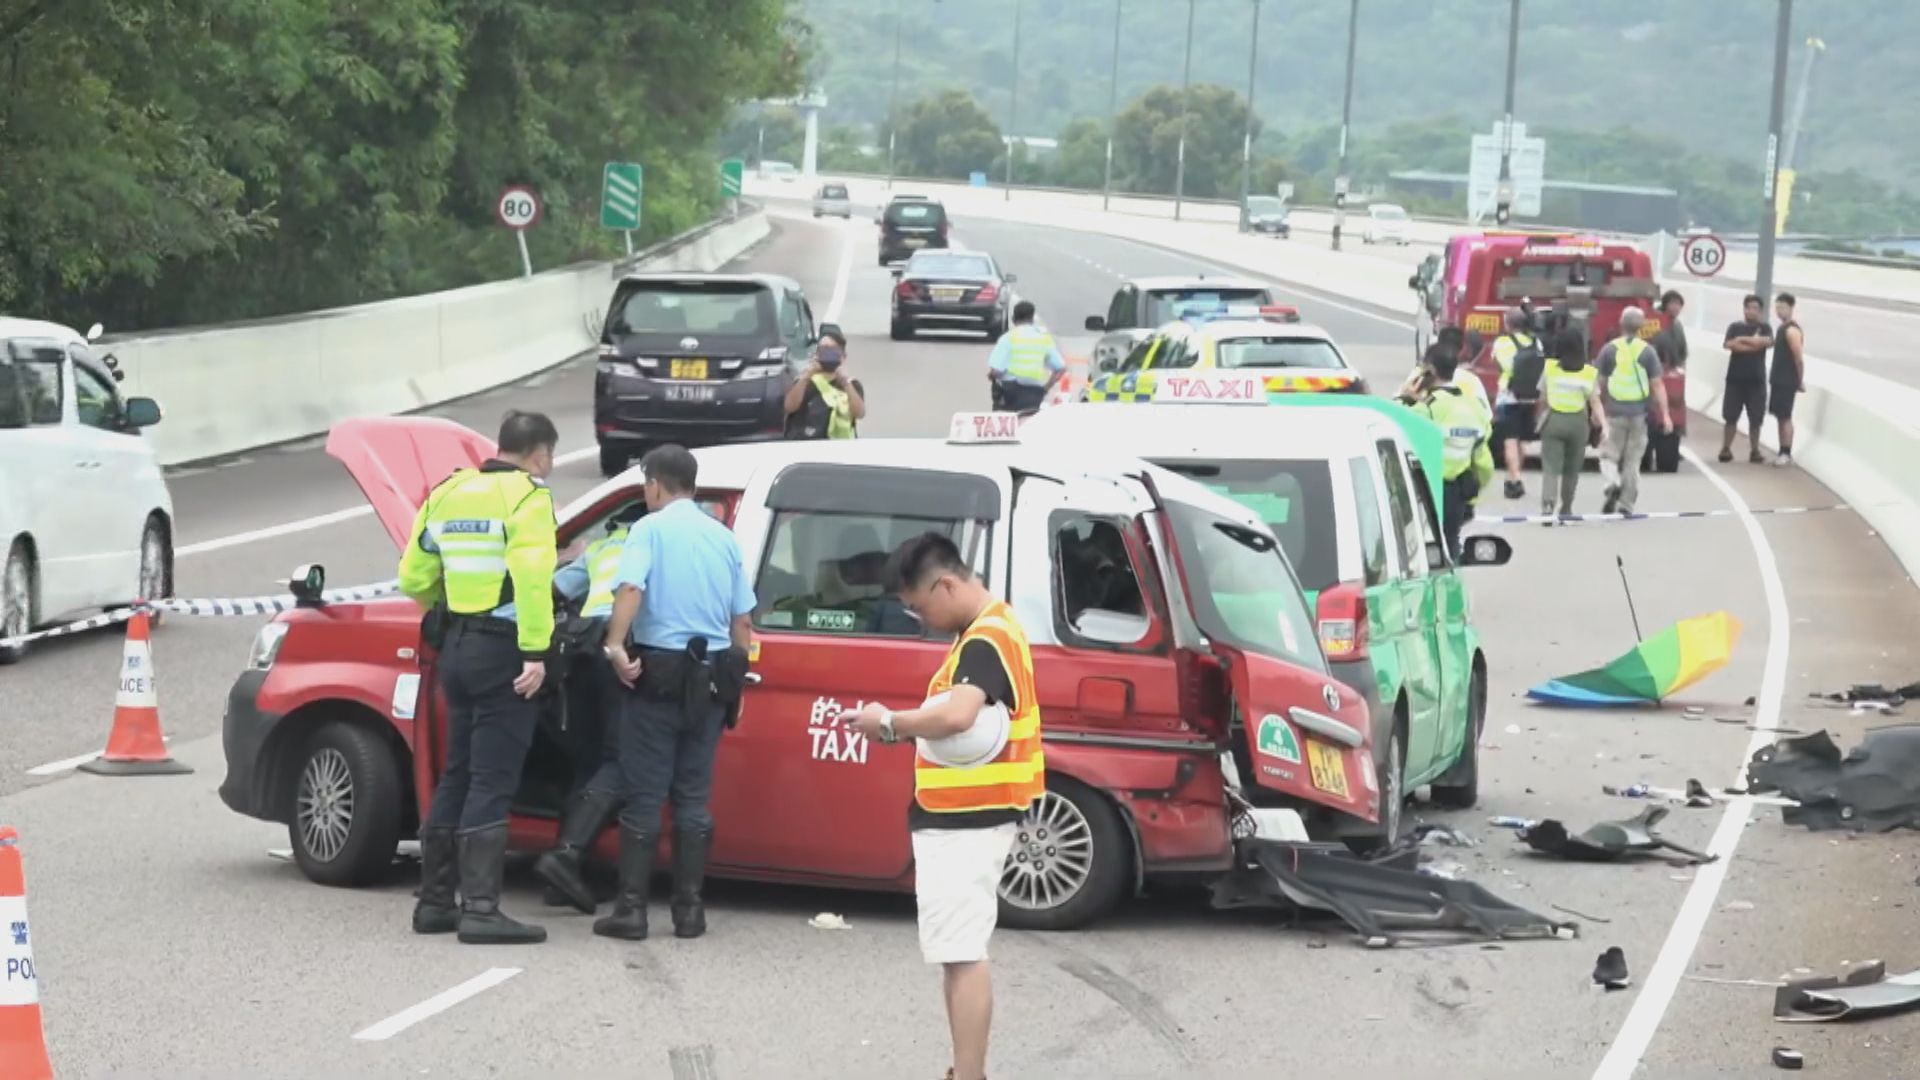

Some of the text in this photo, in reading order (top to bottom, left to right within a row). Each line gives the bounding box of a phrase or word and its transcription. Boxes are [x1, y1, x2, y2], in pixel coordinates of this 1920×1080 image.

[504, 199, 532, 217] 80
[1691, 248, 1720, 266] 80
[1167, 378, 1253, 399] TAXI
[972, 416, 1016, 437] TAXI
[808, 728, 869, 765] TAXI
